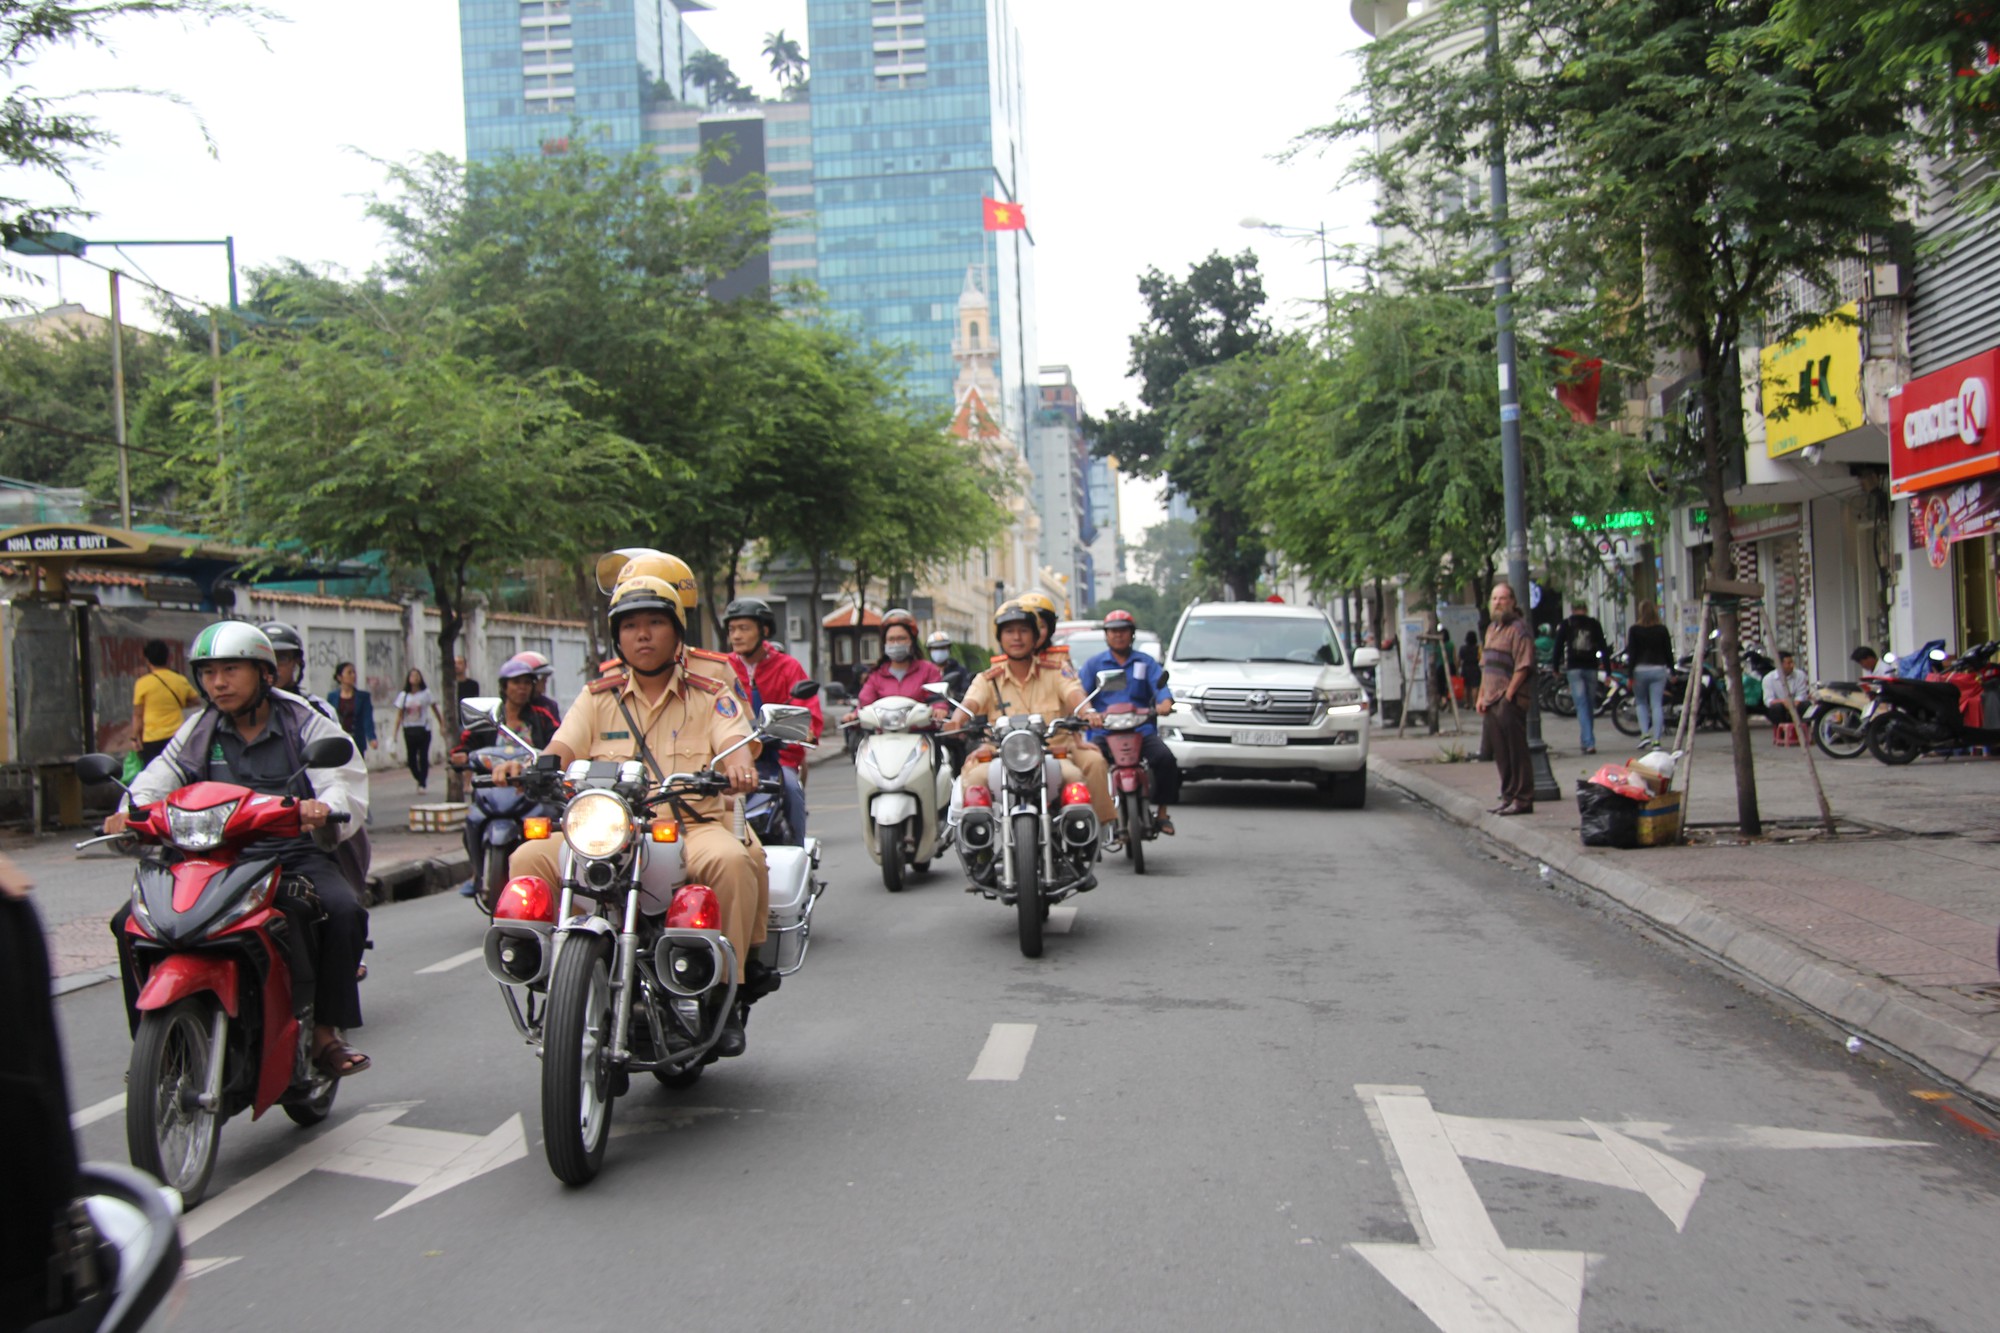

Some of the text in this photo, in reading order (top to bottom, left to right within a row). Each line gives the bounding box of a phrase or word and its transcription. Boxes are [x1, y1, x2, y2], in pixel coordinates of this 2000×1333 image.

[1903, 398, 1959, 449] CIRCLE
[7, 535, 32, 551] NHÀ
[34, 533, 58, 551] CHỜ
[61, 535, 76, 550] XE
